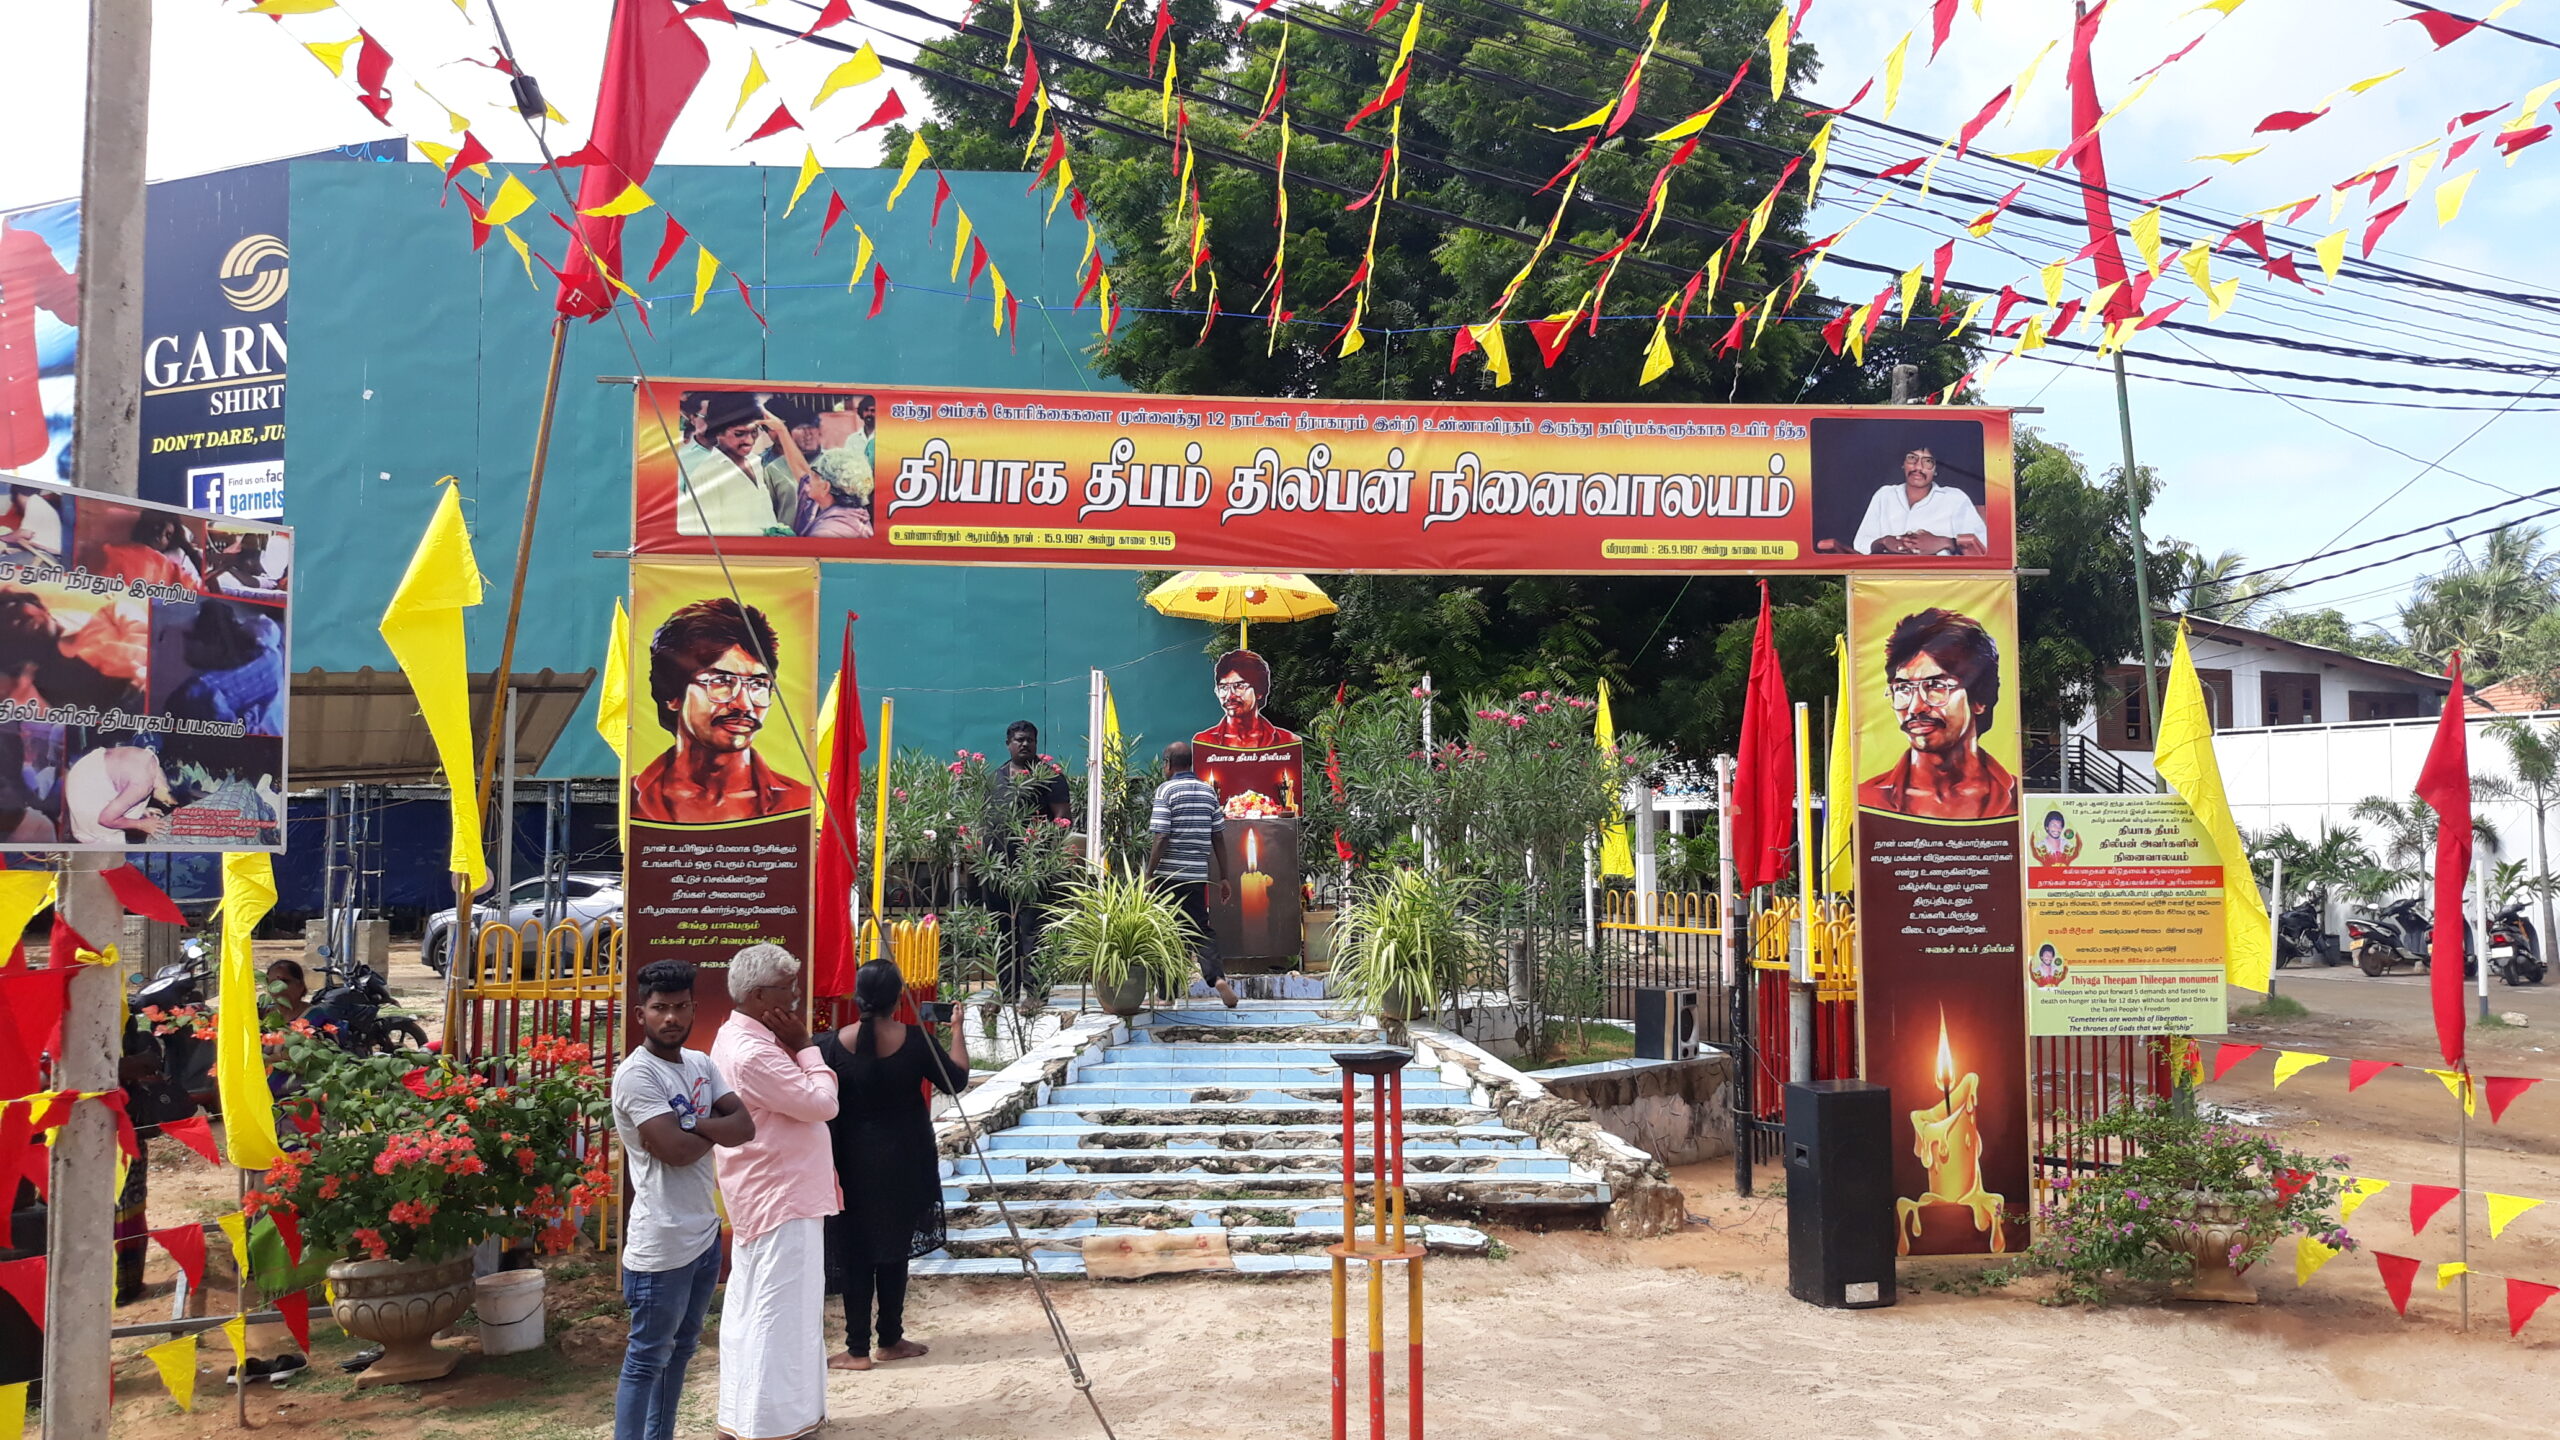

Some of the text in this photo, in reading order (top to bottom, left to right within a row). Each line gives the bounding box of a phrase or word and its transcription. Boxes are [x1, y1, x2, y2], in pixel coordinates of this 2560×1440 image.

[891, 401, 931, 421] ஐந்து
[937, 403, 987, 419] அம்சக்
[993, 404, 1112, 423] கோரிக்கைகளை
[1118, 408, 1201, 428] முன்வைத்து
[1206, 412, 1225, 426] 12
[1230, 412, 1291, 430] நாட்கள்
[1296, 411, 1368, 432] நீராகாரம்
[1373, 416, 1418, 434] இன்றி
[1423, 416, 1533, 435] உண்ணாவிரதம்
[1539, 419, 1593, 437] இருந்து
[1731, 421, 1769, 437] உயிர்
[1774, 420, 1806, 440] நீத்த
[151, 432, 205, 454] DON’T
[206, 427, 259, 448] DARE,
[266, 468, 284, 483] fac
[887, 437, 1796, 531] தியாக தீபம் திலீபன் நினைவாலயம்
[965, 531, 1010, 545] ஆரம்பித்த
[1013, 532, 1034, 545] நாள்
[1044, 533, 1084, 545] 15.9.1987
[1087, 534, 1116, 547] அன்று
[1119, 535, 1146, 546] காலை
[1149, 535, 1171, 546] 9.45
[1606, 542, 1784, 557] வீரமரணம் 26.9.1987 அன்று காலை 10.48
[20, 564, 64, 585] துளி
[98, 707, 175, 735] தியாகப்
[176, 717, 247, 739] பயணம்
[1206, 752, 1291, 763] தியாக தீபம் திலீபன்
[2118, 824, 2180, 836] தியாக தீபம்
[642, 844, 667, 855] நான்
[716, 845, 751, 854] மேலாக
[752, 844, 798, 856] நேசிக்கும்
[1874, 840, 1896, 849] நான்
[1897, 838, 1944, 850] மனரீதியாக
[2099, 838, 2199, 850] திலீபன் அவர்களின்
[1871, 854, 1892, 864] எமது
[1893, 853, 1922, 862] மக்கள்
[2113, 851, 2189, 863] நினைவாலயம்
[642, 859, 693, 869] உங்களிடம்
[695, 861, 712, 870] ஒரு
[714, 860, 745, 870] பெரும்
[1895, 868, 1919, 879] என்று
[1963, 883, 1989, 893] பூரண
[672, 889, 766, 901] நீங்கள் அனைவரும்
[677, 920, 708, 931] இங்கு
[1901, 925, 1925, 934] விடை
[650, 935, 686, 946] மக்கள்
[688, 935, 719, 947] புரட்சி
[1980, 943, 2015, 955] திலீபன்
[2071, 975, 2219, 987] Thiyaga Theepam Thileepan monument
[2147, 1015, 2156, 1023] of
